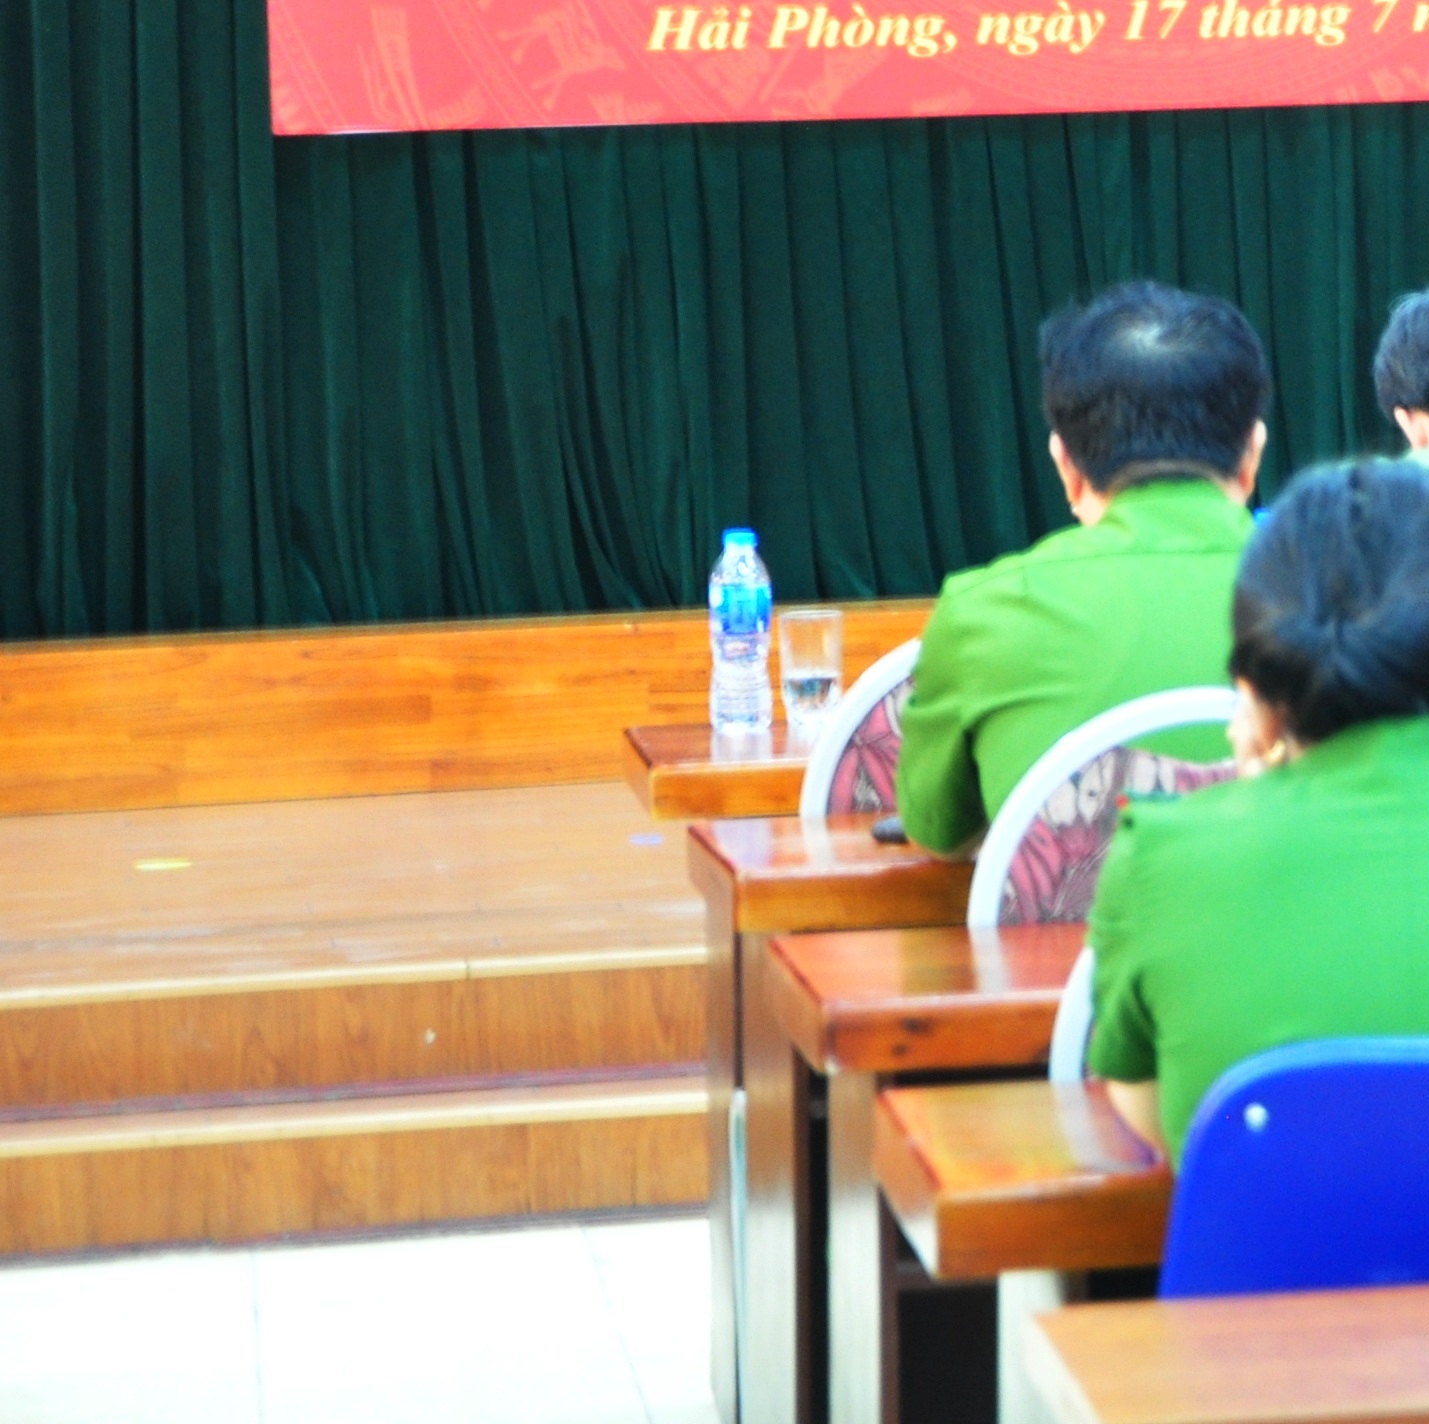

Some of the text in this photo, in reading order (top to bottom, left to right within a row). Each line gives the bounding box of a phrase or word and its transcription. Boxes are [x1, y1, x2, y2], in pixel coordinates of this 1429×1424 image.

[650, 8, 751, 50] Hải
[770, 5, 956, 56] Phòng,
[978, 1, 1104, 54] ngày
